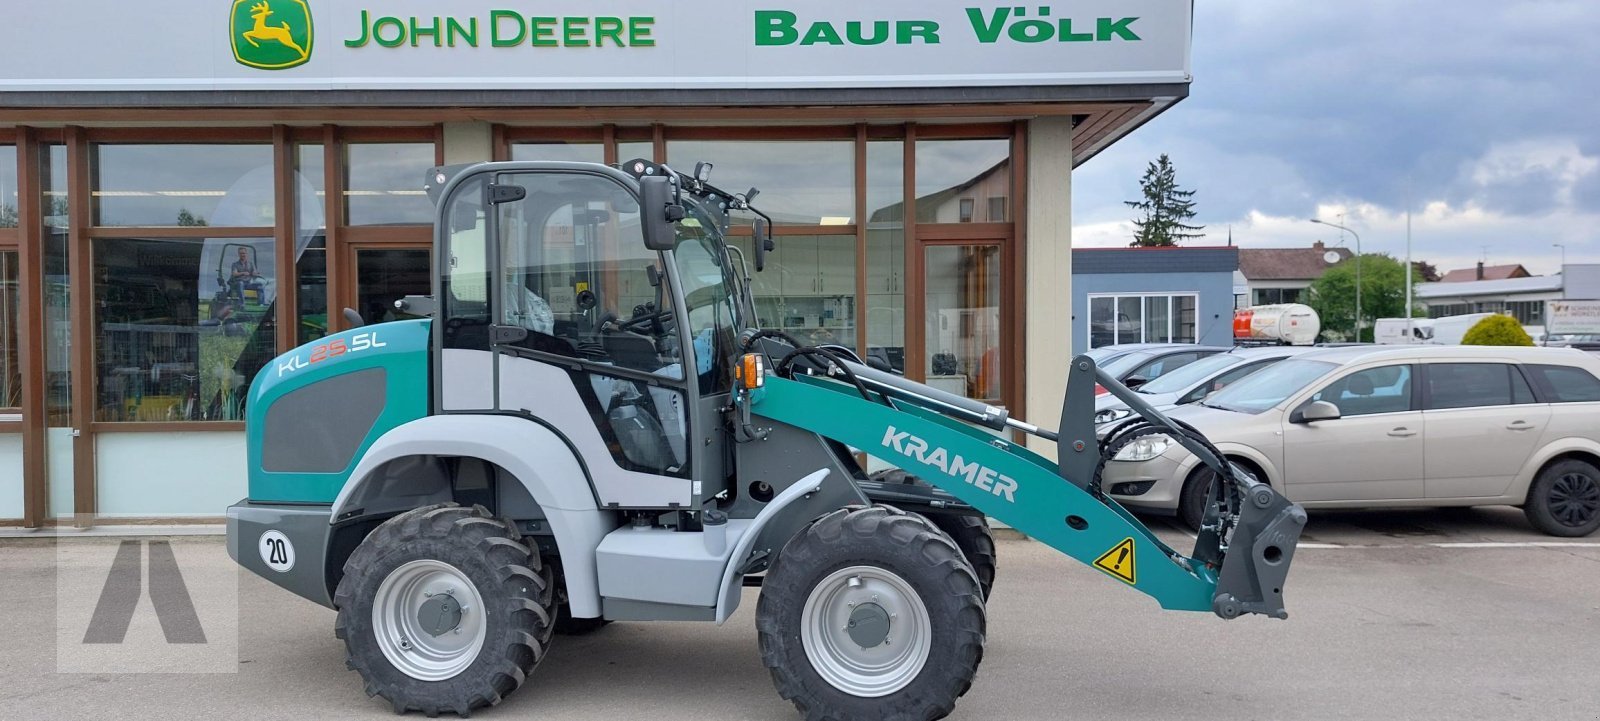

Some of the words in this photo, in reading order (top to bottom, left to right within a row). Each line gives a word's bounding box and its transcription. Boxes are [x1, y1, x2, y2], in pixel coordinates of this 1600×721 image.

[344, 9, 478, 48] JOHN
[490, 9, 656, 48] DEERE
[754, 9, 941, 46] BAUR
[965, 6, 1142, 43] VÖLK
[138, 253, 200, 266] Willkomme
[278, 331, 387, 377] KL25.5L
[881, 425, 1019, 503] KRAMER
[266, 537, 288, 565] 20
